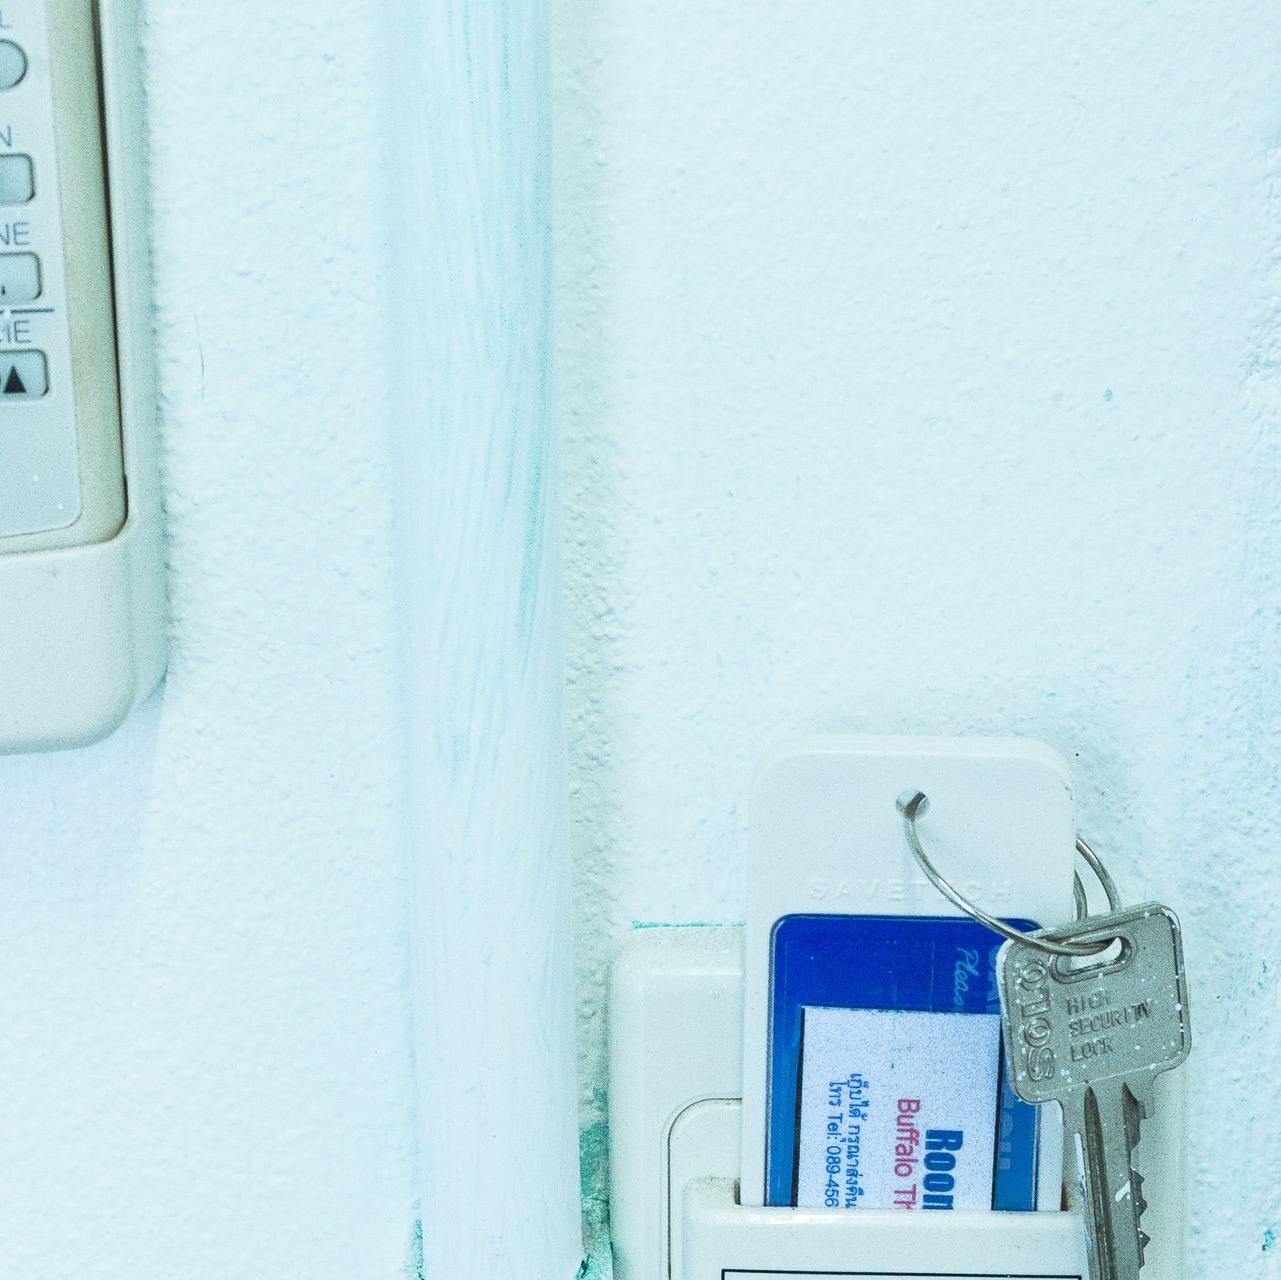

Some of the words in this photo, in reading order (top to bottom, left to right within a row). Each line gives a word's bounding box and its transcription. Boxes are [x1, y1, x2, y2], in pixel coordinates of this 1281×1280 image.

[808, 877, 1012, 903] SAVETCH
[1070, 1036, 1114, 1063] LOCK
[827, 1113, 844, 1140] Tel:
[894, 1098, 921, 1178] Buffalo
[824, 1145, 842, 1208] 089-456
